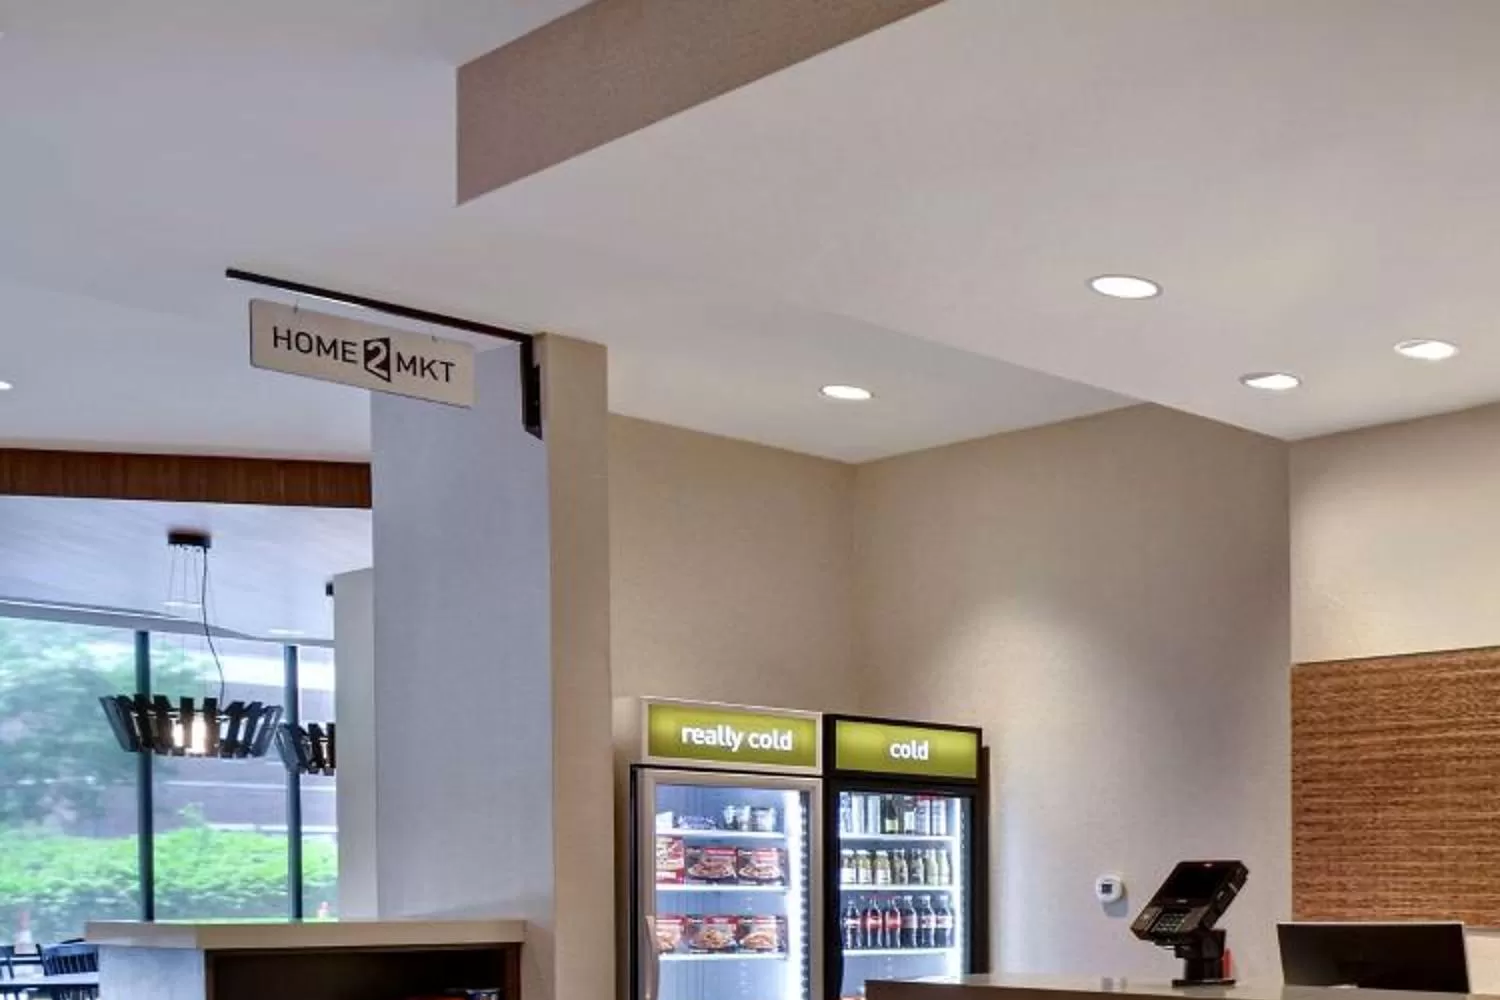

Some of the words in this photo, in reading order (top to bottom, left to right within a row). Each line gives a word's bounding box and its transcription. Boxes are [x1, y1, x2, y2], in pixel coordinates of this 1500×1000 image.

[681, 724, 744, 752] really
[748, 731, 793, 751] cold
[889, 740, 930, 761] cold
